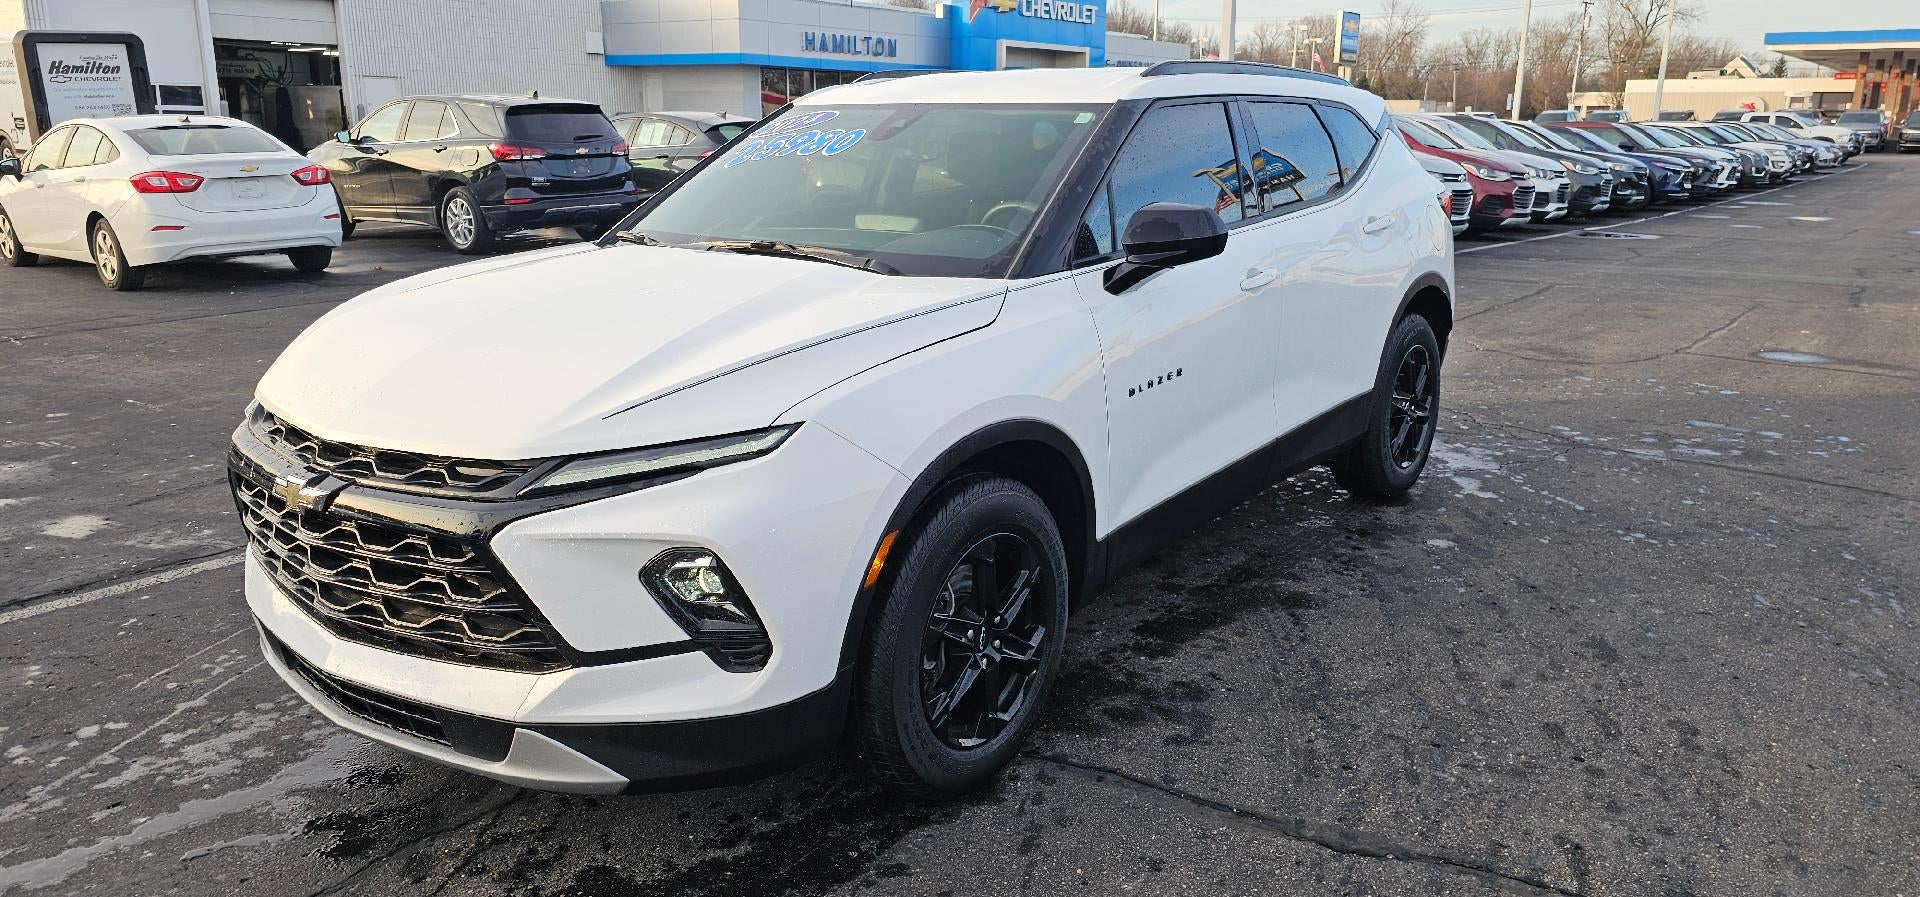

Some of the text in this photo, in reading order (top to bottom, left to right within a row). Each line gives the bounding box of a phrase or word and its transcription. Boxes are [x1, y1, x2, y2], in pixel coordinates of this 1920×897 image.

[1022, 0, 1098, 24] CHEVROLET
[803, 31, 897, 57] HAMILTON
[48, 60, 121, 75] Hamilton
[723, 128, 867, 169] 25980
[1128, 367, 1183, 398] BLAZER
